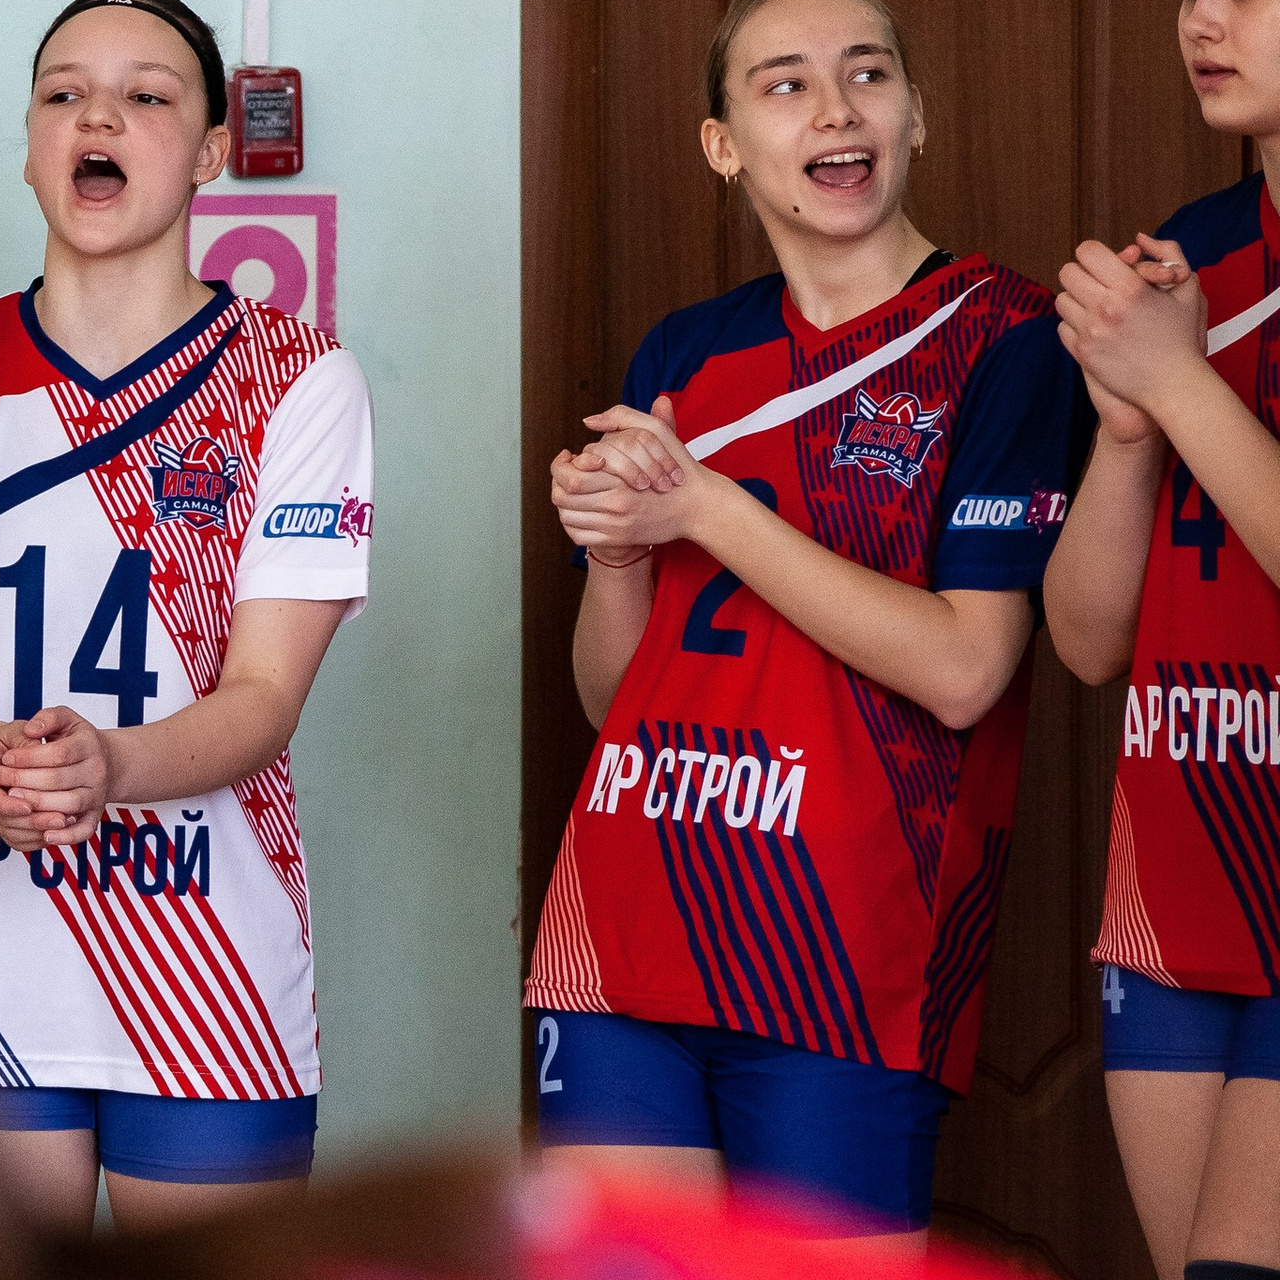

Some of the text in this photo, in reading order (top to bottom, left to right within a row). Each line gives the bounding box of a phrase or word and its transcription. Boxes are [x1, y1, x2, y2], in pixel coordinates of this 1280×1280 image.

[847, 418, 922, 460] ИСКРА
[853, 446, 903, 467] САМАРА
[269, 507, 335, 535] СШОР
[952, 499, 1023, 526] СШОР
[1124, 685, 1163, 758] АР
[586, 743, 807, 837] АР СТРОЙ
[538, 1016, 563, 1094] 2
